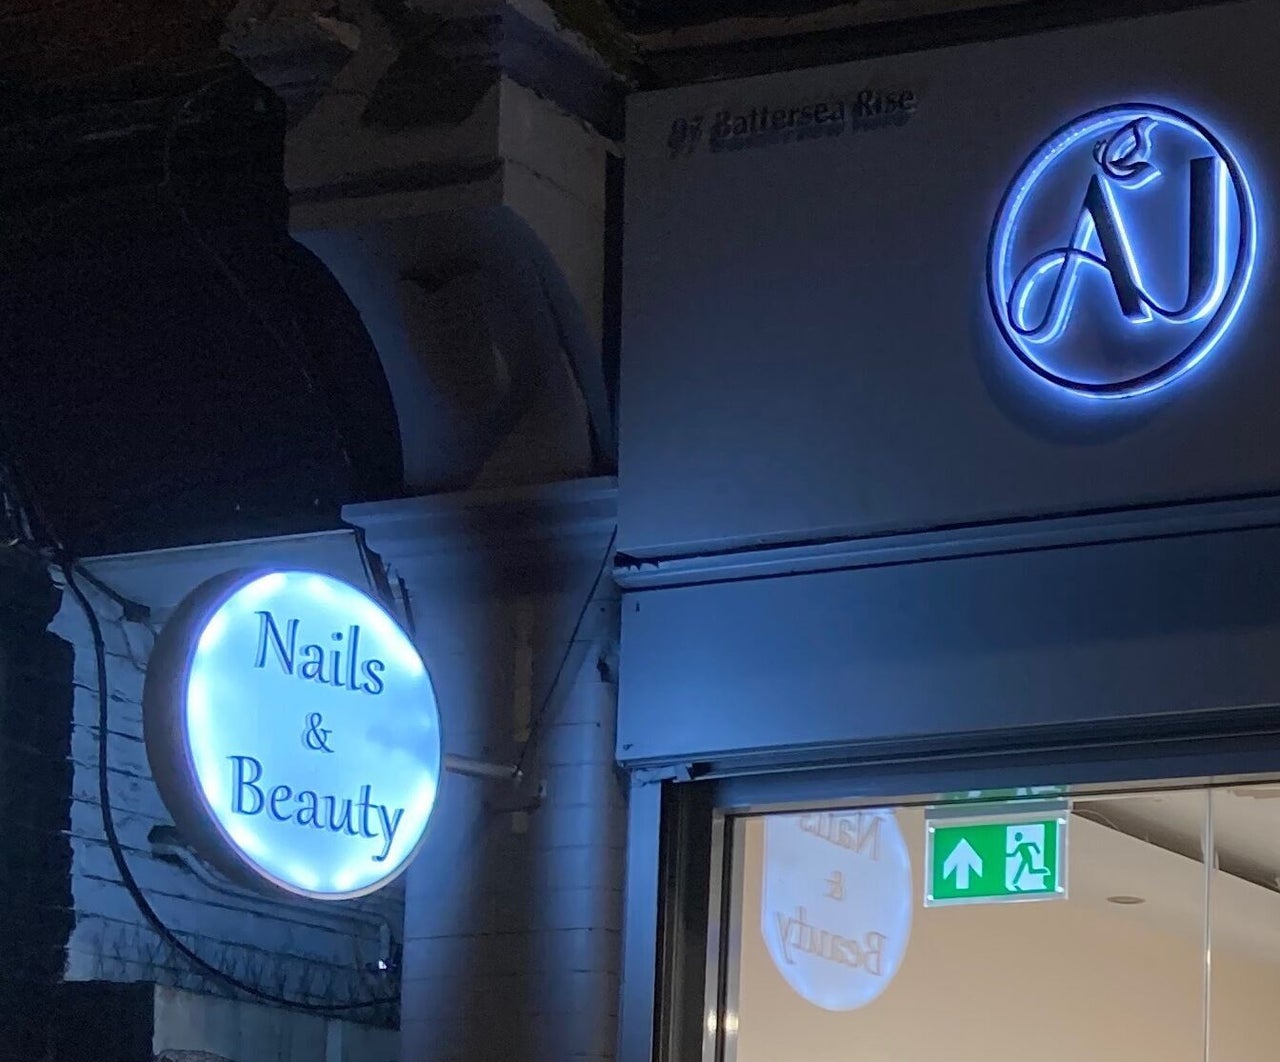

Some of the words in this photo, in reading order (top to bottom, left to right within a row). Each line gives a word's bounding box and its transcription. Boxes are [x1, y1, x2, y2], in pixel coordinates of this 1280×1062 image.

[711, 101, 846, 141] Battersea
[854, 88, 917, 118] Rise
[254, 610, 386, 695] Nails
[304, 711, 335, 753] &
[225, 755, 405, 862] Beauty
